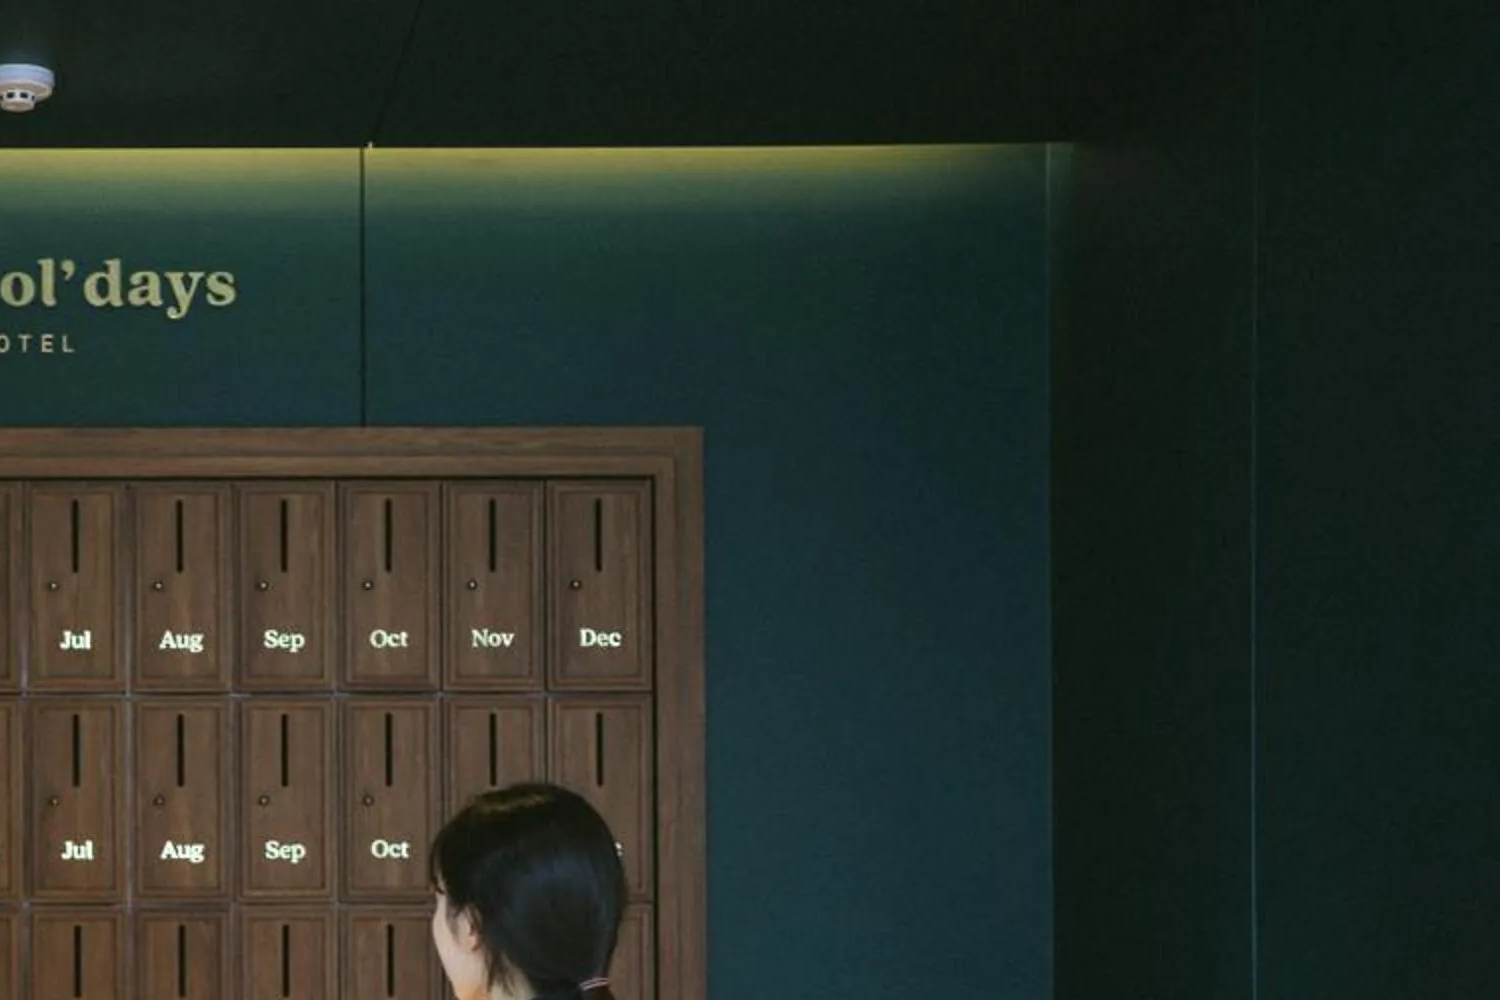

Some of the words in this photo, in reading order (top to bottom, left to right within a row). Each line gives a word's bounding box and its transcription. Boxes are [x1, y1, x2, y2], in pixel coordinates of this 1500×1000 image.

[60, 630, 92, 650] Jul
[159, 630, 204, 652] Aug
[263, 629, 306, 652] Sep
[369, 629, 409, 648] Oct
[471, 629, 515, 648] Nov
[580, 629, 622, 648] Dec
[61, 840, 94, 861] Jul
[160, 840, 205, 863] Aug
[265, 841, 306, 864] Sep
[371, 839, 410, 859] Oct
